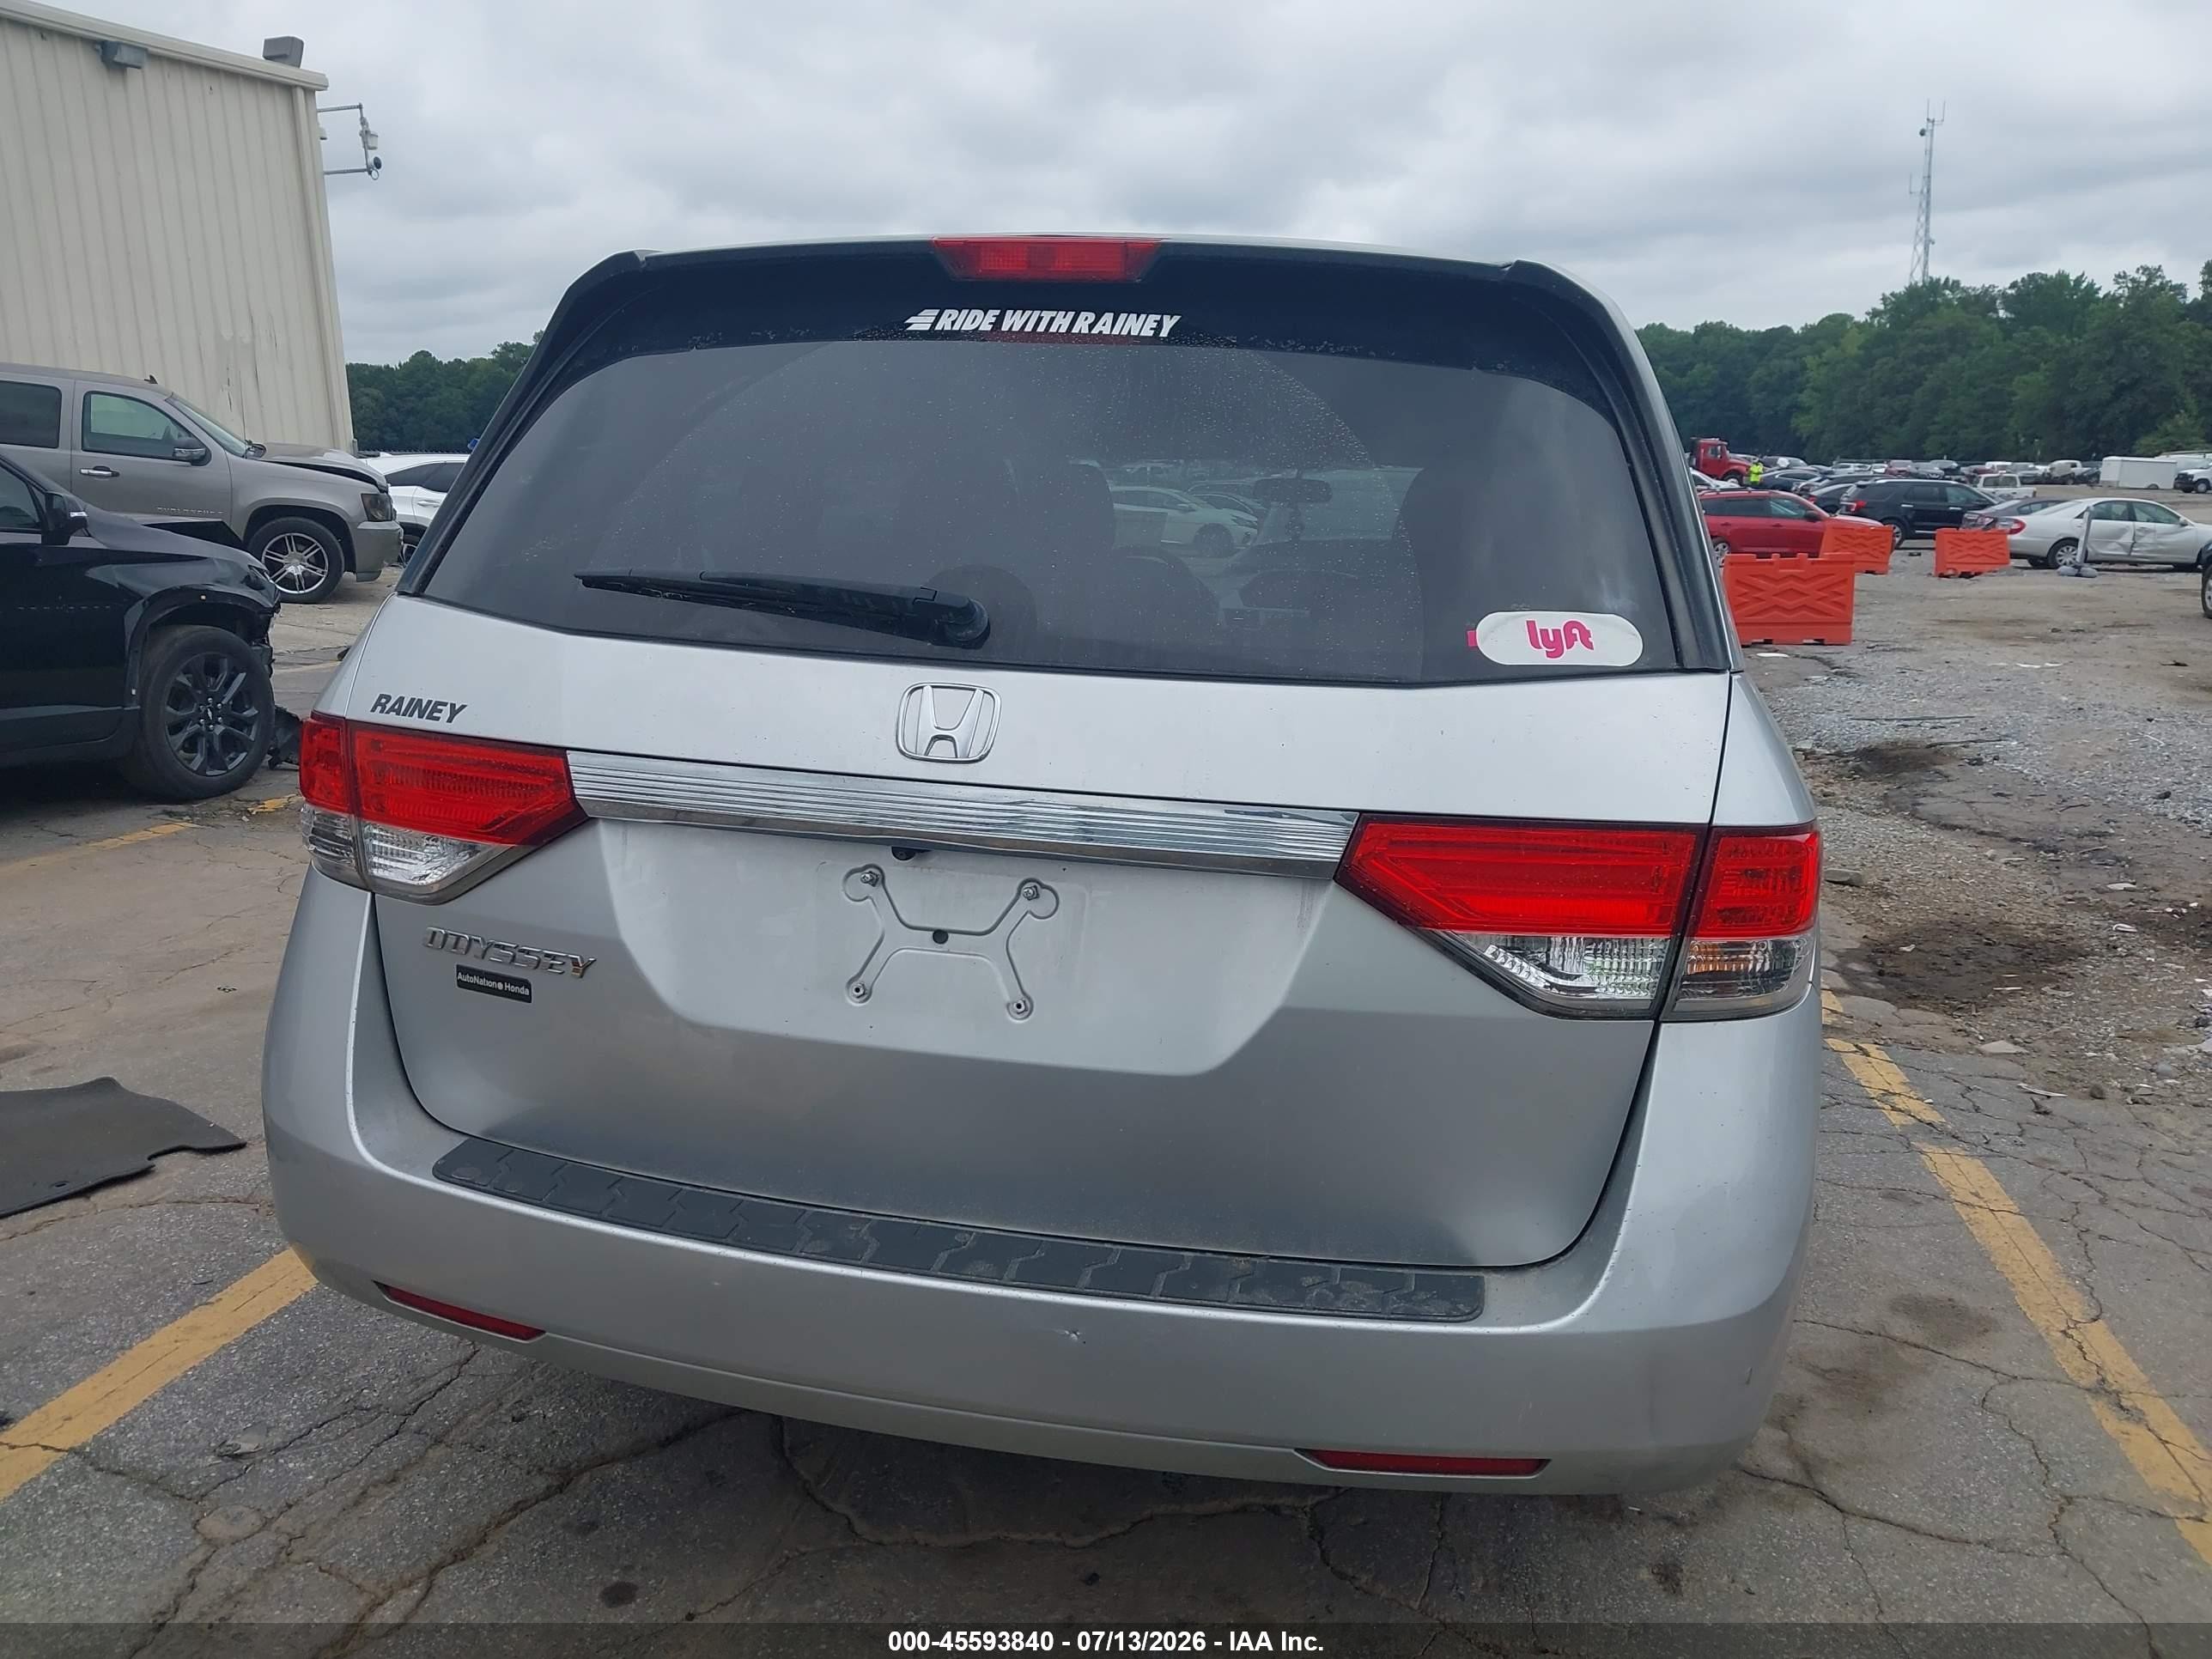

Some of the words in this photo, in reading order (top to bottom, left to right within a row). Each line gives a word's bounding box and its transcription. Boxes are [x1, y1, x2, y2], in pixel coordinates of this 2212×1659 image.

[935, 309, 1001, 331] RIDE
[1000, 309, 1076, 333] WITH
[1072, 312, 1182, 337] RAINEY
[1526, 619, 1595, 659] lyft
[369, 693, 468, 724] RAINEY
[424, 927, 597, 978] ODYSSEY
